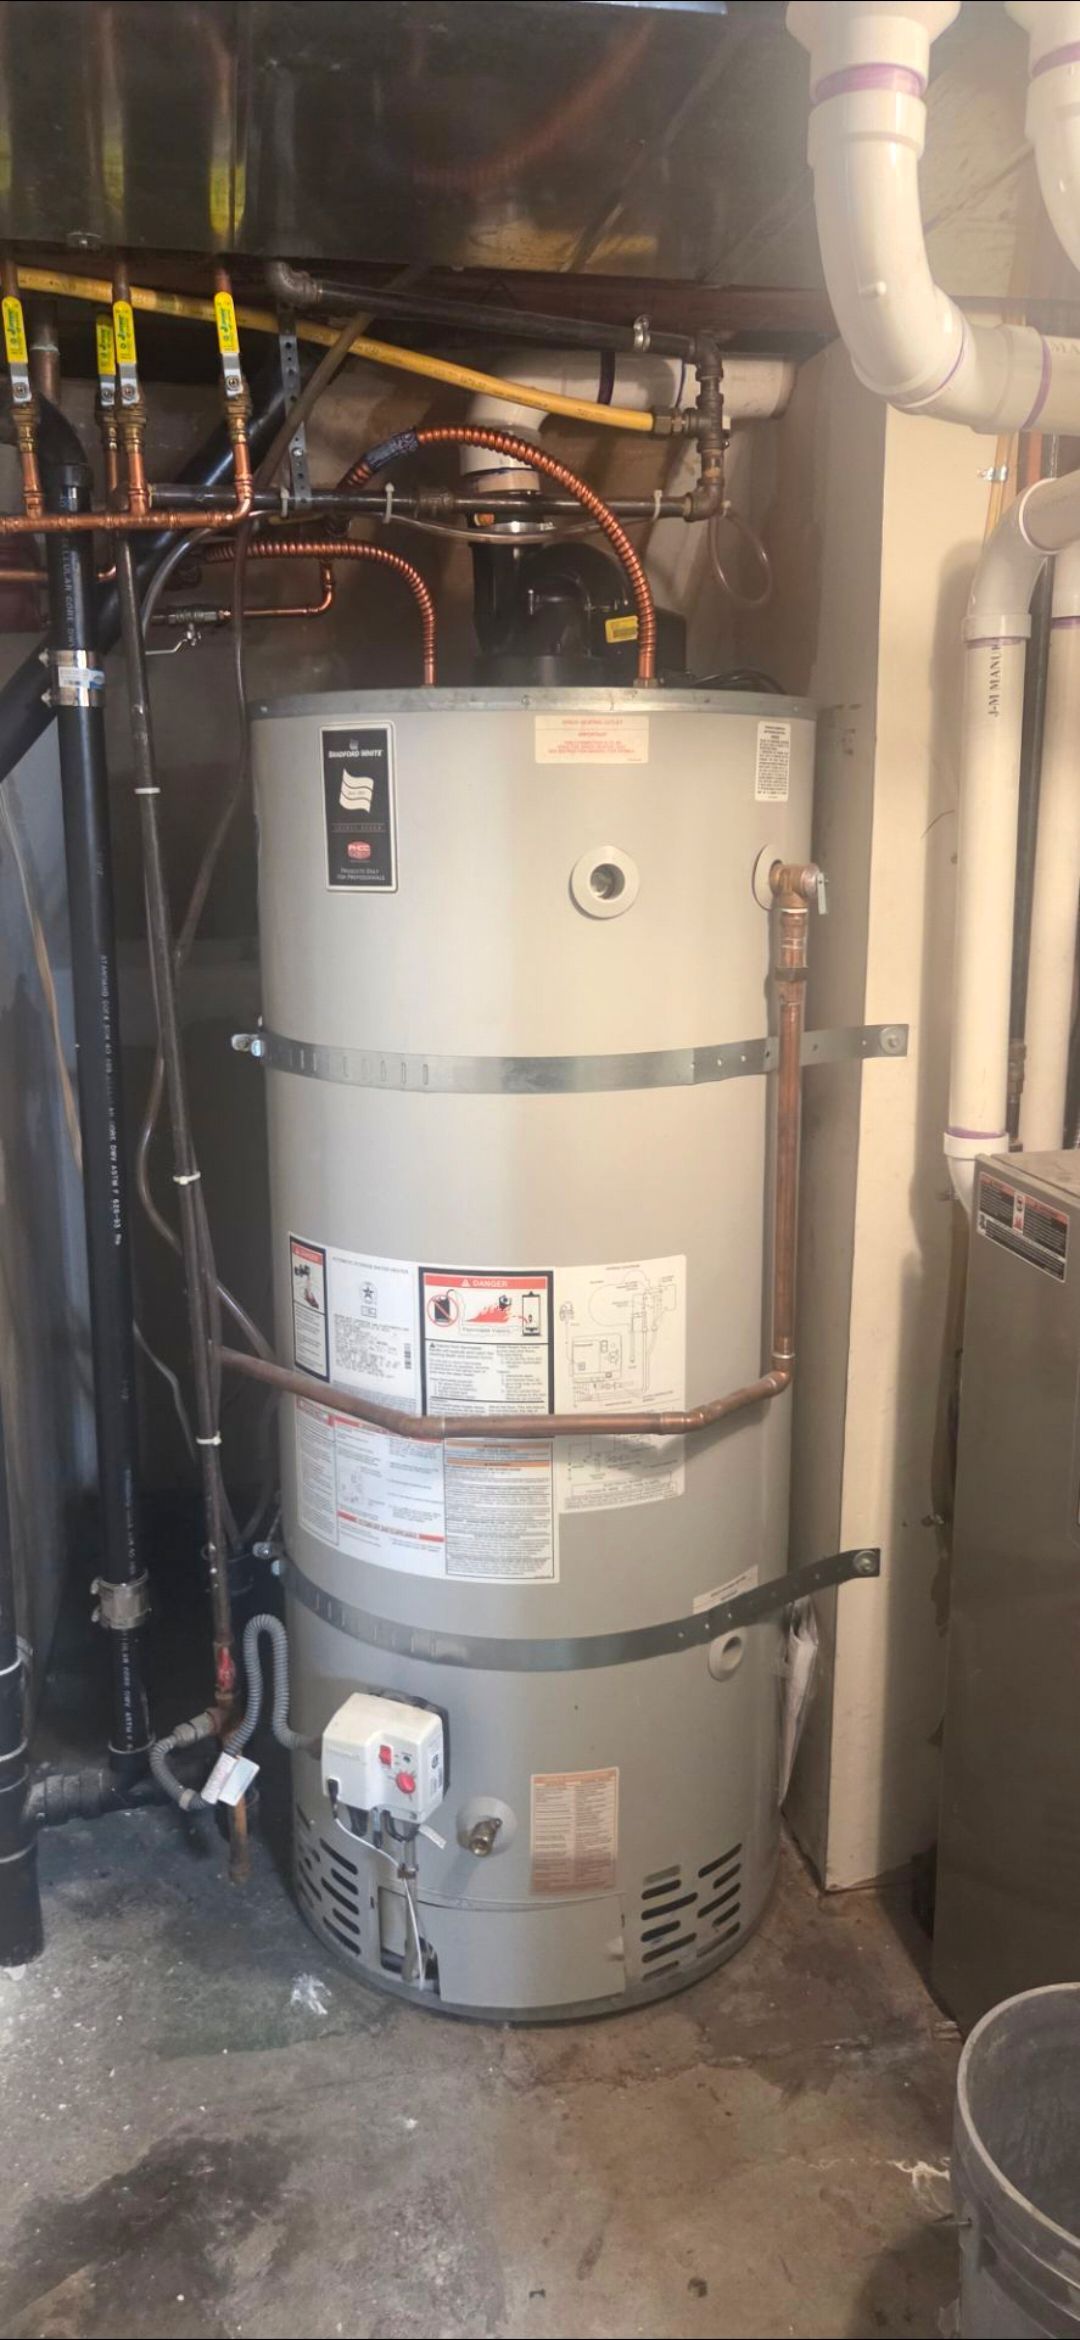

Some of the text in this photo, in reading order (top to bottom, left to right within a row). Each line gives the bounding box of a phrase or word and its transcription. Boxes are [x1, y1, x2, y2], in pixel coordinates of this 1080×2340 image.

[988, 694, 1000, 718] J-M
[328, 749, 383, 758] BRADFORD WHITE
[110, 1144, 118, 1161] DWV
[111, 1165, 119, 1186] ASTM
[472, 1280, 508, 1288] DANGER
